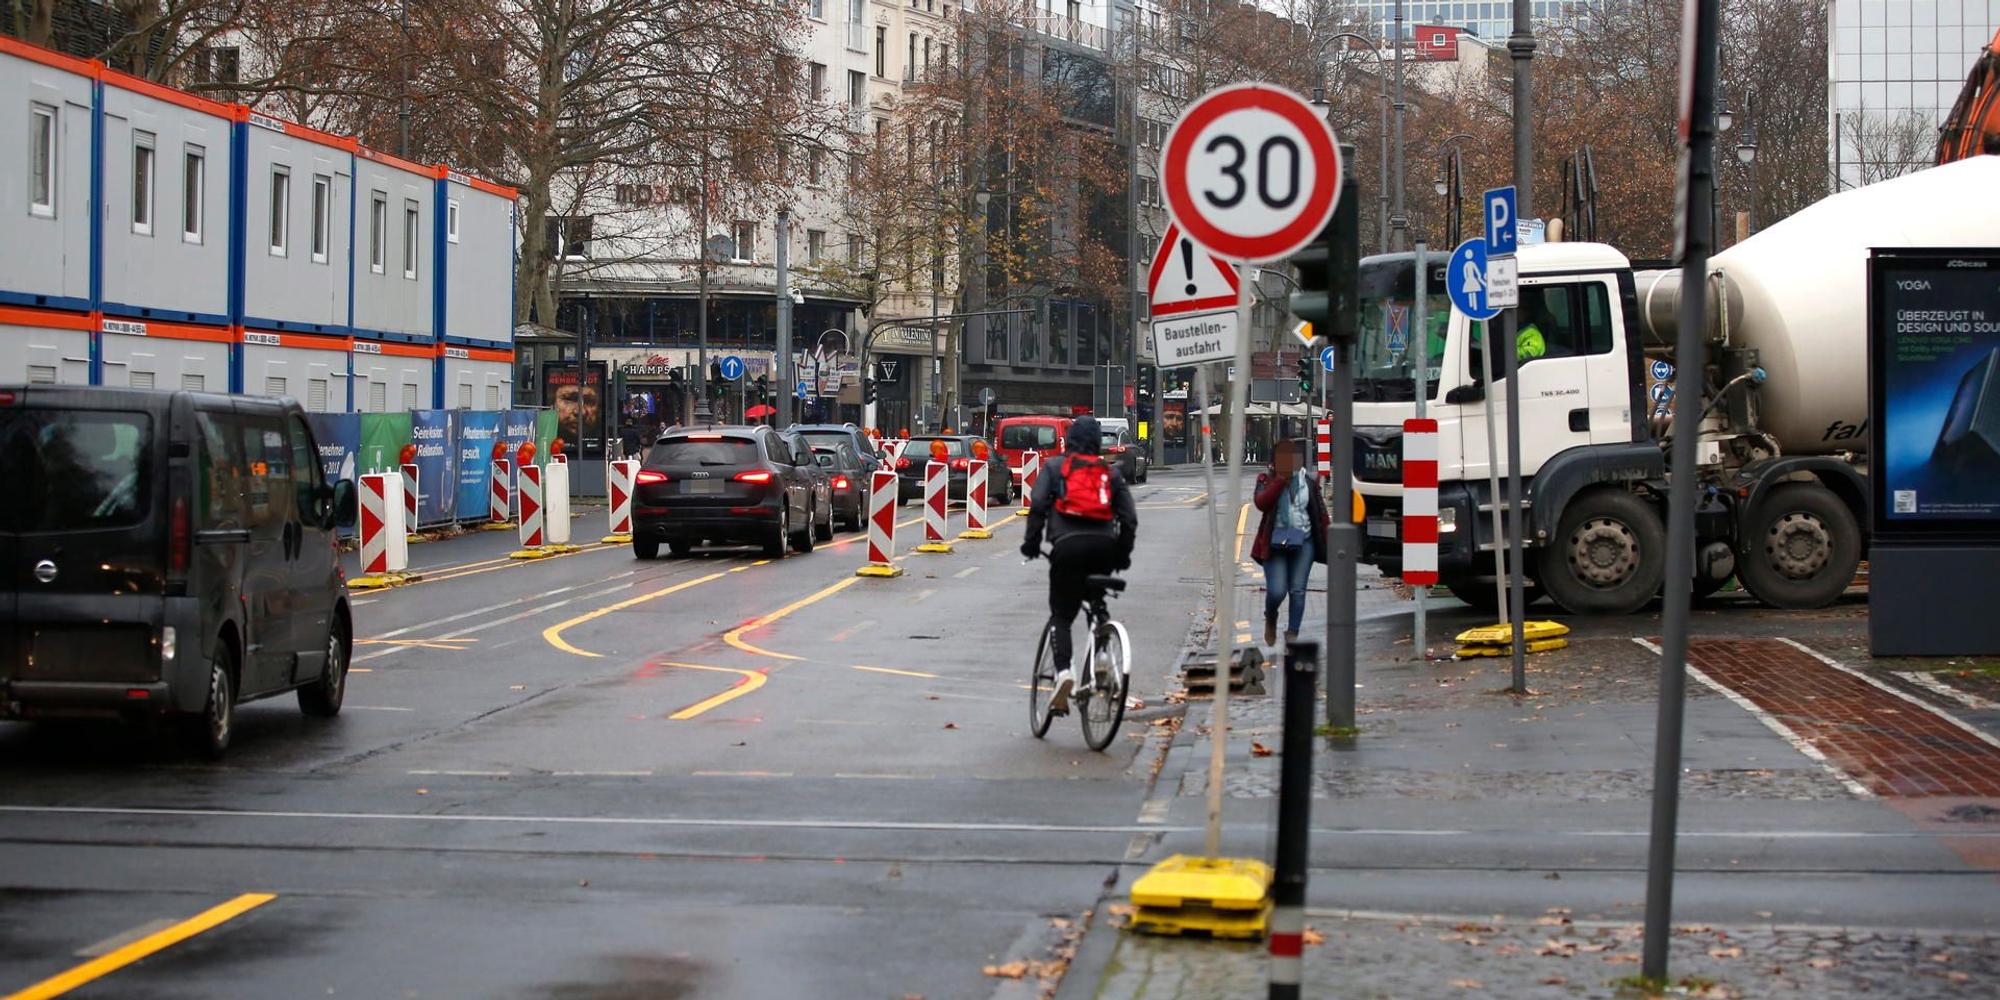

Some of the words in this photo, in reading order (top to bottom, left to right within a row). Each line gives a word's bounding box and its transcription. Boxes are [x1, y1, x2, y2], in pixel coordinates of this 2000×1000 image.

[1204, 135, 1301, 209] 30
[1491, 197, 1509, 247] P
[1946, 260, 1988, 268] JCDecaux
[1896, 280, 1932, 290] YOGA
[1896, 309, 1969, 321] ÜBERZEUGT
[1971, 311, 1985, 321] IN
[1164, 323, 1228, 341] Baustellen-
[1897, 322, 1941, 333] DESIGN
[1944, 322, 1971, 333] UND
[1974, 322, 2000, 333] SOU
[1176, 340, 1222, 358] ausfahrt
[622, 365, 671, 375] CHAMPS
[1364, 453, 1398, 469] MAN
